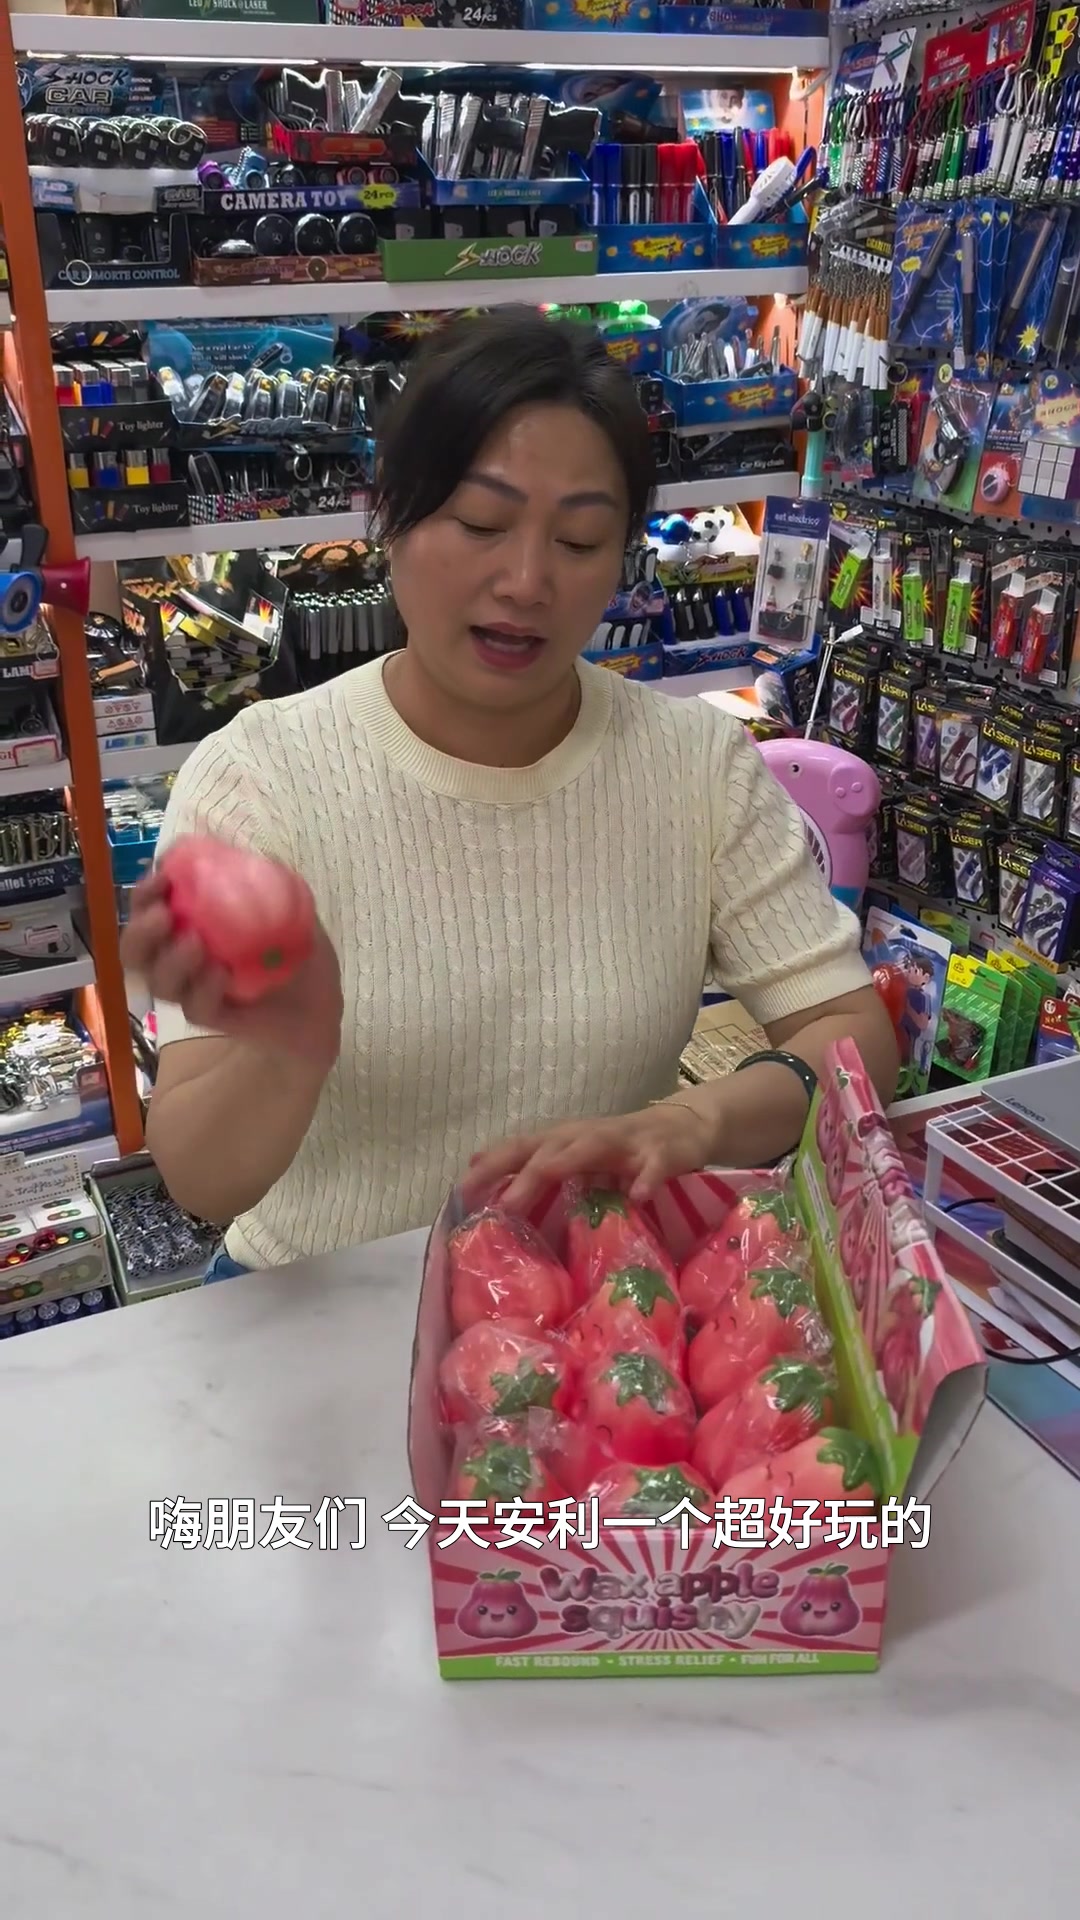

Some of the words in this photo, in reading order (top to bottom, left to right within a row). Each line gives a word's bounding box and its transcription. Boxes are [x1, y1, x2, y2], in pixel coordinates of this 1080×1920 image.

[45, 87, 112, 106] CAR
[221, 190, 308, 211] CAMERA
[311, 189, 349, 208] TOY
[132, 268, 180, 280] CONTROL
[118, 421, 135, 432] Toy
[136, 420, 164, 431] lighter
[132, 504, 150, 515] Toy
[152, 502, 179, 513] lighter
[915, 694, 938, 713] LAS
[983, 717, 1019, 748] LASER
[1022, 736, 1061, 761] LASER
[997, 846, 1031, 878] LASE
[28, 875, 55, 888] PEN
[1005, 1097, 1046, 1122] Lenovo
[540, 1567, 649, 1600] Wax
[655, 1562, 780, 1604] apple
[561, 1596, 763, 1639] squishy
[496, 1655, 529, 1667] FAST
[533, 1655, 600, 1667] REBOUND
[618, 1655, 671, 1666] STRESS
[675, 1653, 724, 1666] RELIEF
[796, 1652, 820, 1664] ALL
